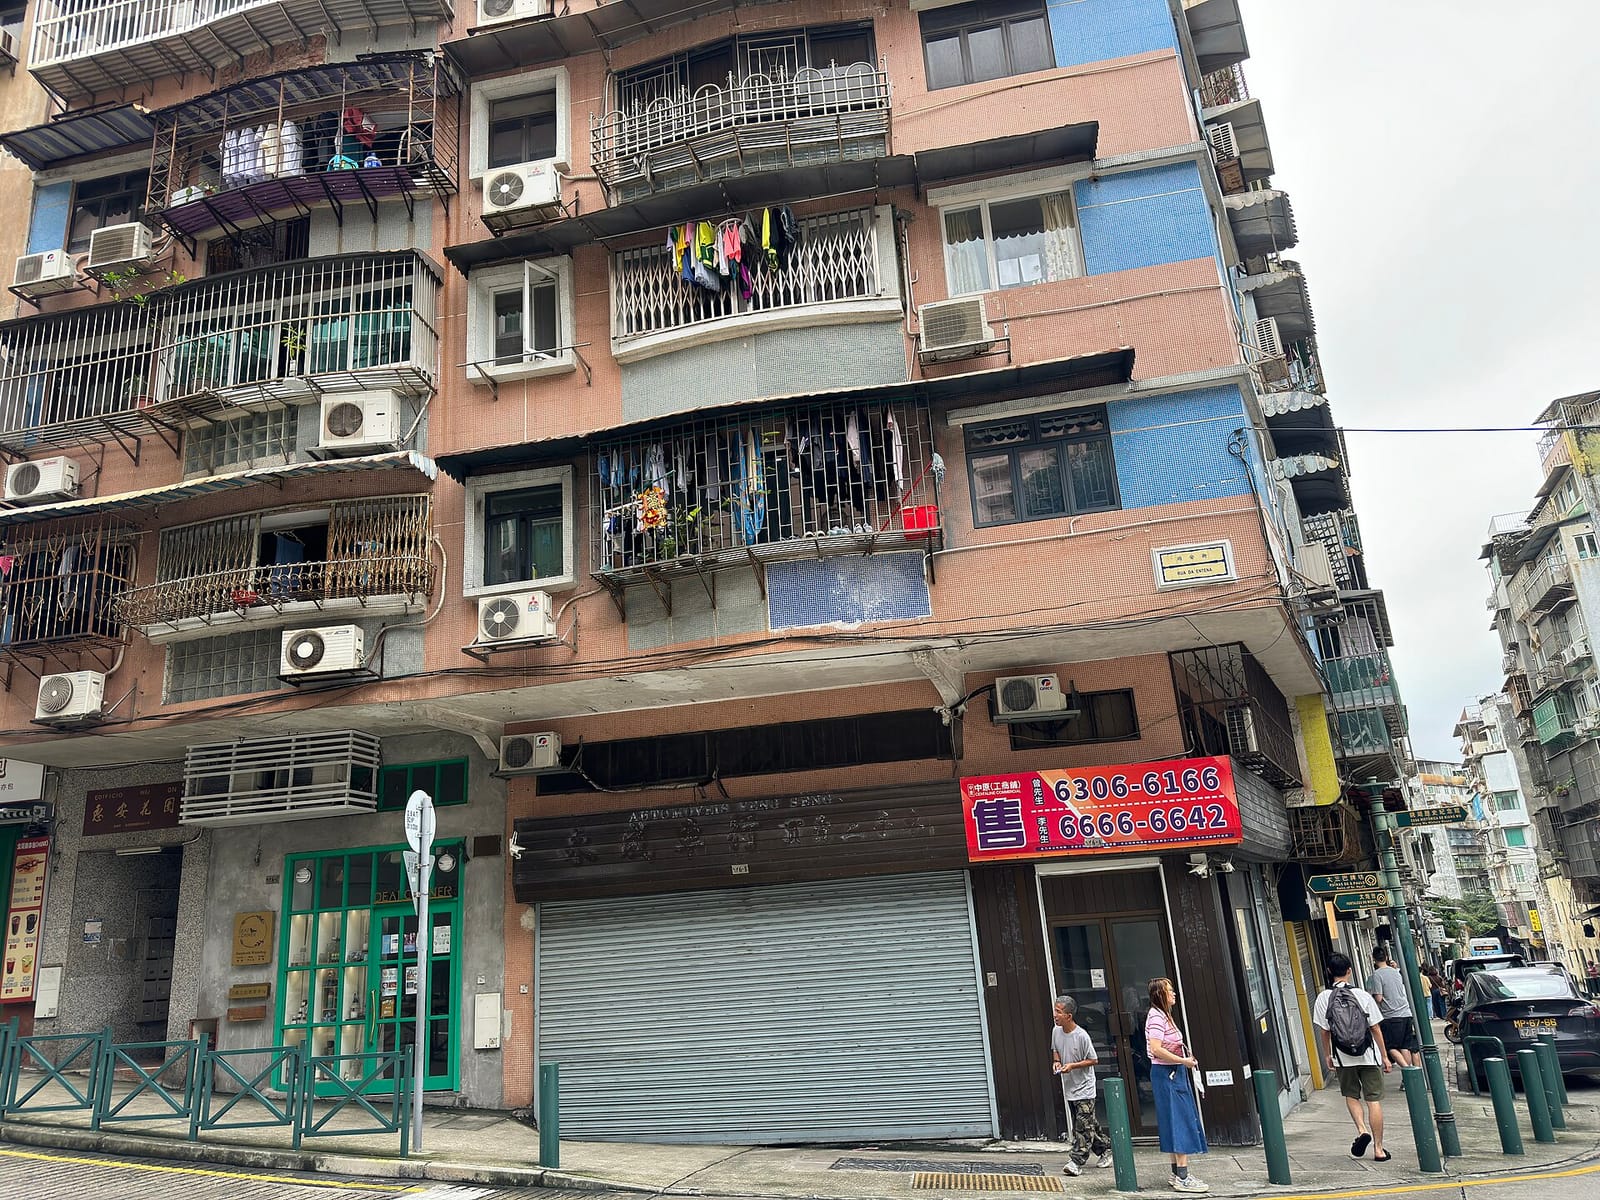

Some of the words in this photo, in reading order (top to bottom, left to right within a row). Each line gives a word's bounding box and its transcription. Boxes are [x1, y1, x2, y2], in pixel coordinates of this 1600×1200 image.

[1032, 778, 1044, 805] 曾先生
[1053, 766, 1220, 801] 6306-6166
[972, 797, 1026, 851] 售
[1037, 816, 1049, 844] 李先生
[1059, 804, 1227, 839] 6666-6642
